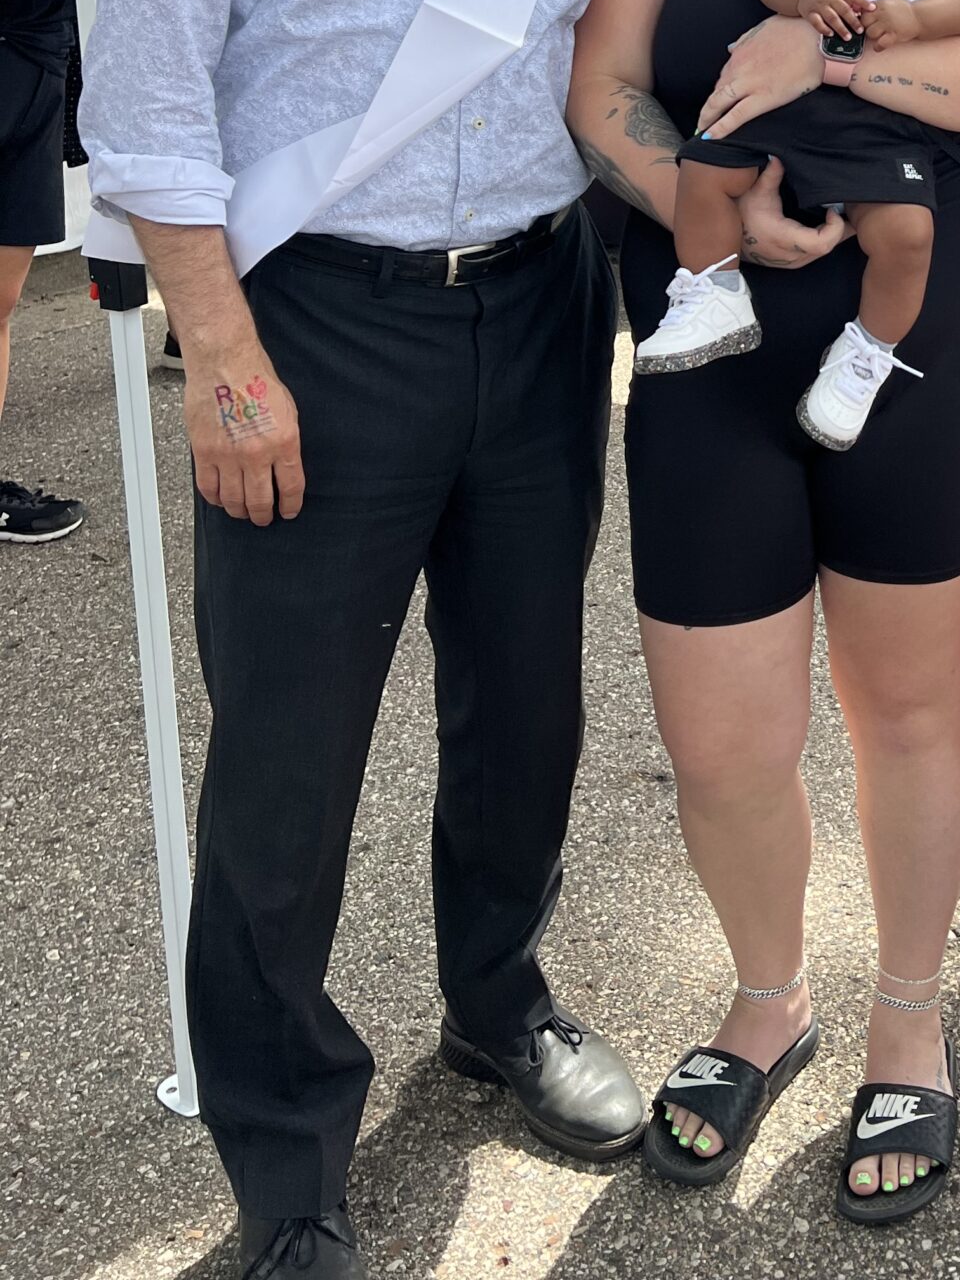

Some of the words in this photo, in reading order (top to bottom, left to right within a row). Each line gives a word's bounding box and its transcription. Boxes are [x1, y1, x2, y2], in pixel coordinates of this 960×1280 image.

[868, 74, 892, 84] LOVE
[898, 77, 913, 85] YOU
[221, 400, 269, 427] Kids
[682, 1053, 730, 1081] NIKE
[867, 1093, 921, 1118] NIKE
